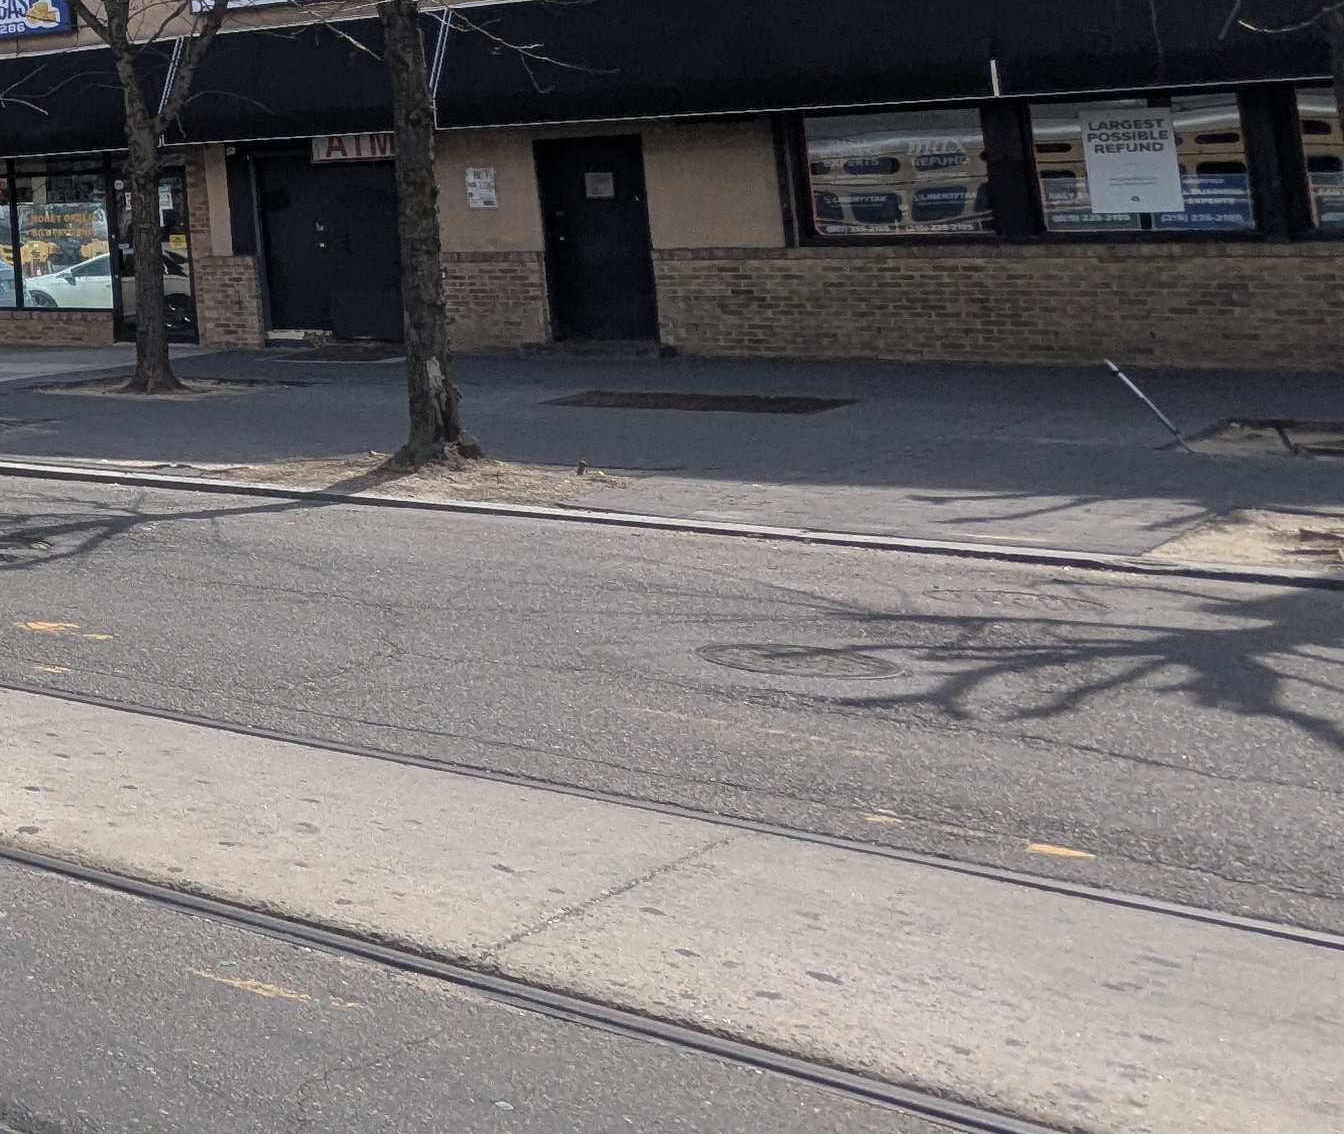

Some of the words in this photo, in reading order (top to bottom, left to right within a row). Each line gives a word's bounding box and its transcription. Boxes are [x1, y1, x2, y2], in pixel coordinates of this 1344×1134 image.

[1088, 119, 1164, 130] LARGEST
[1087, 130, 1168, 143] POSSIBLE
[1094, 142, 1164, 154] REFUND
